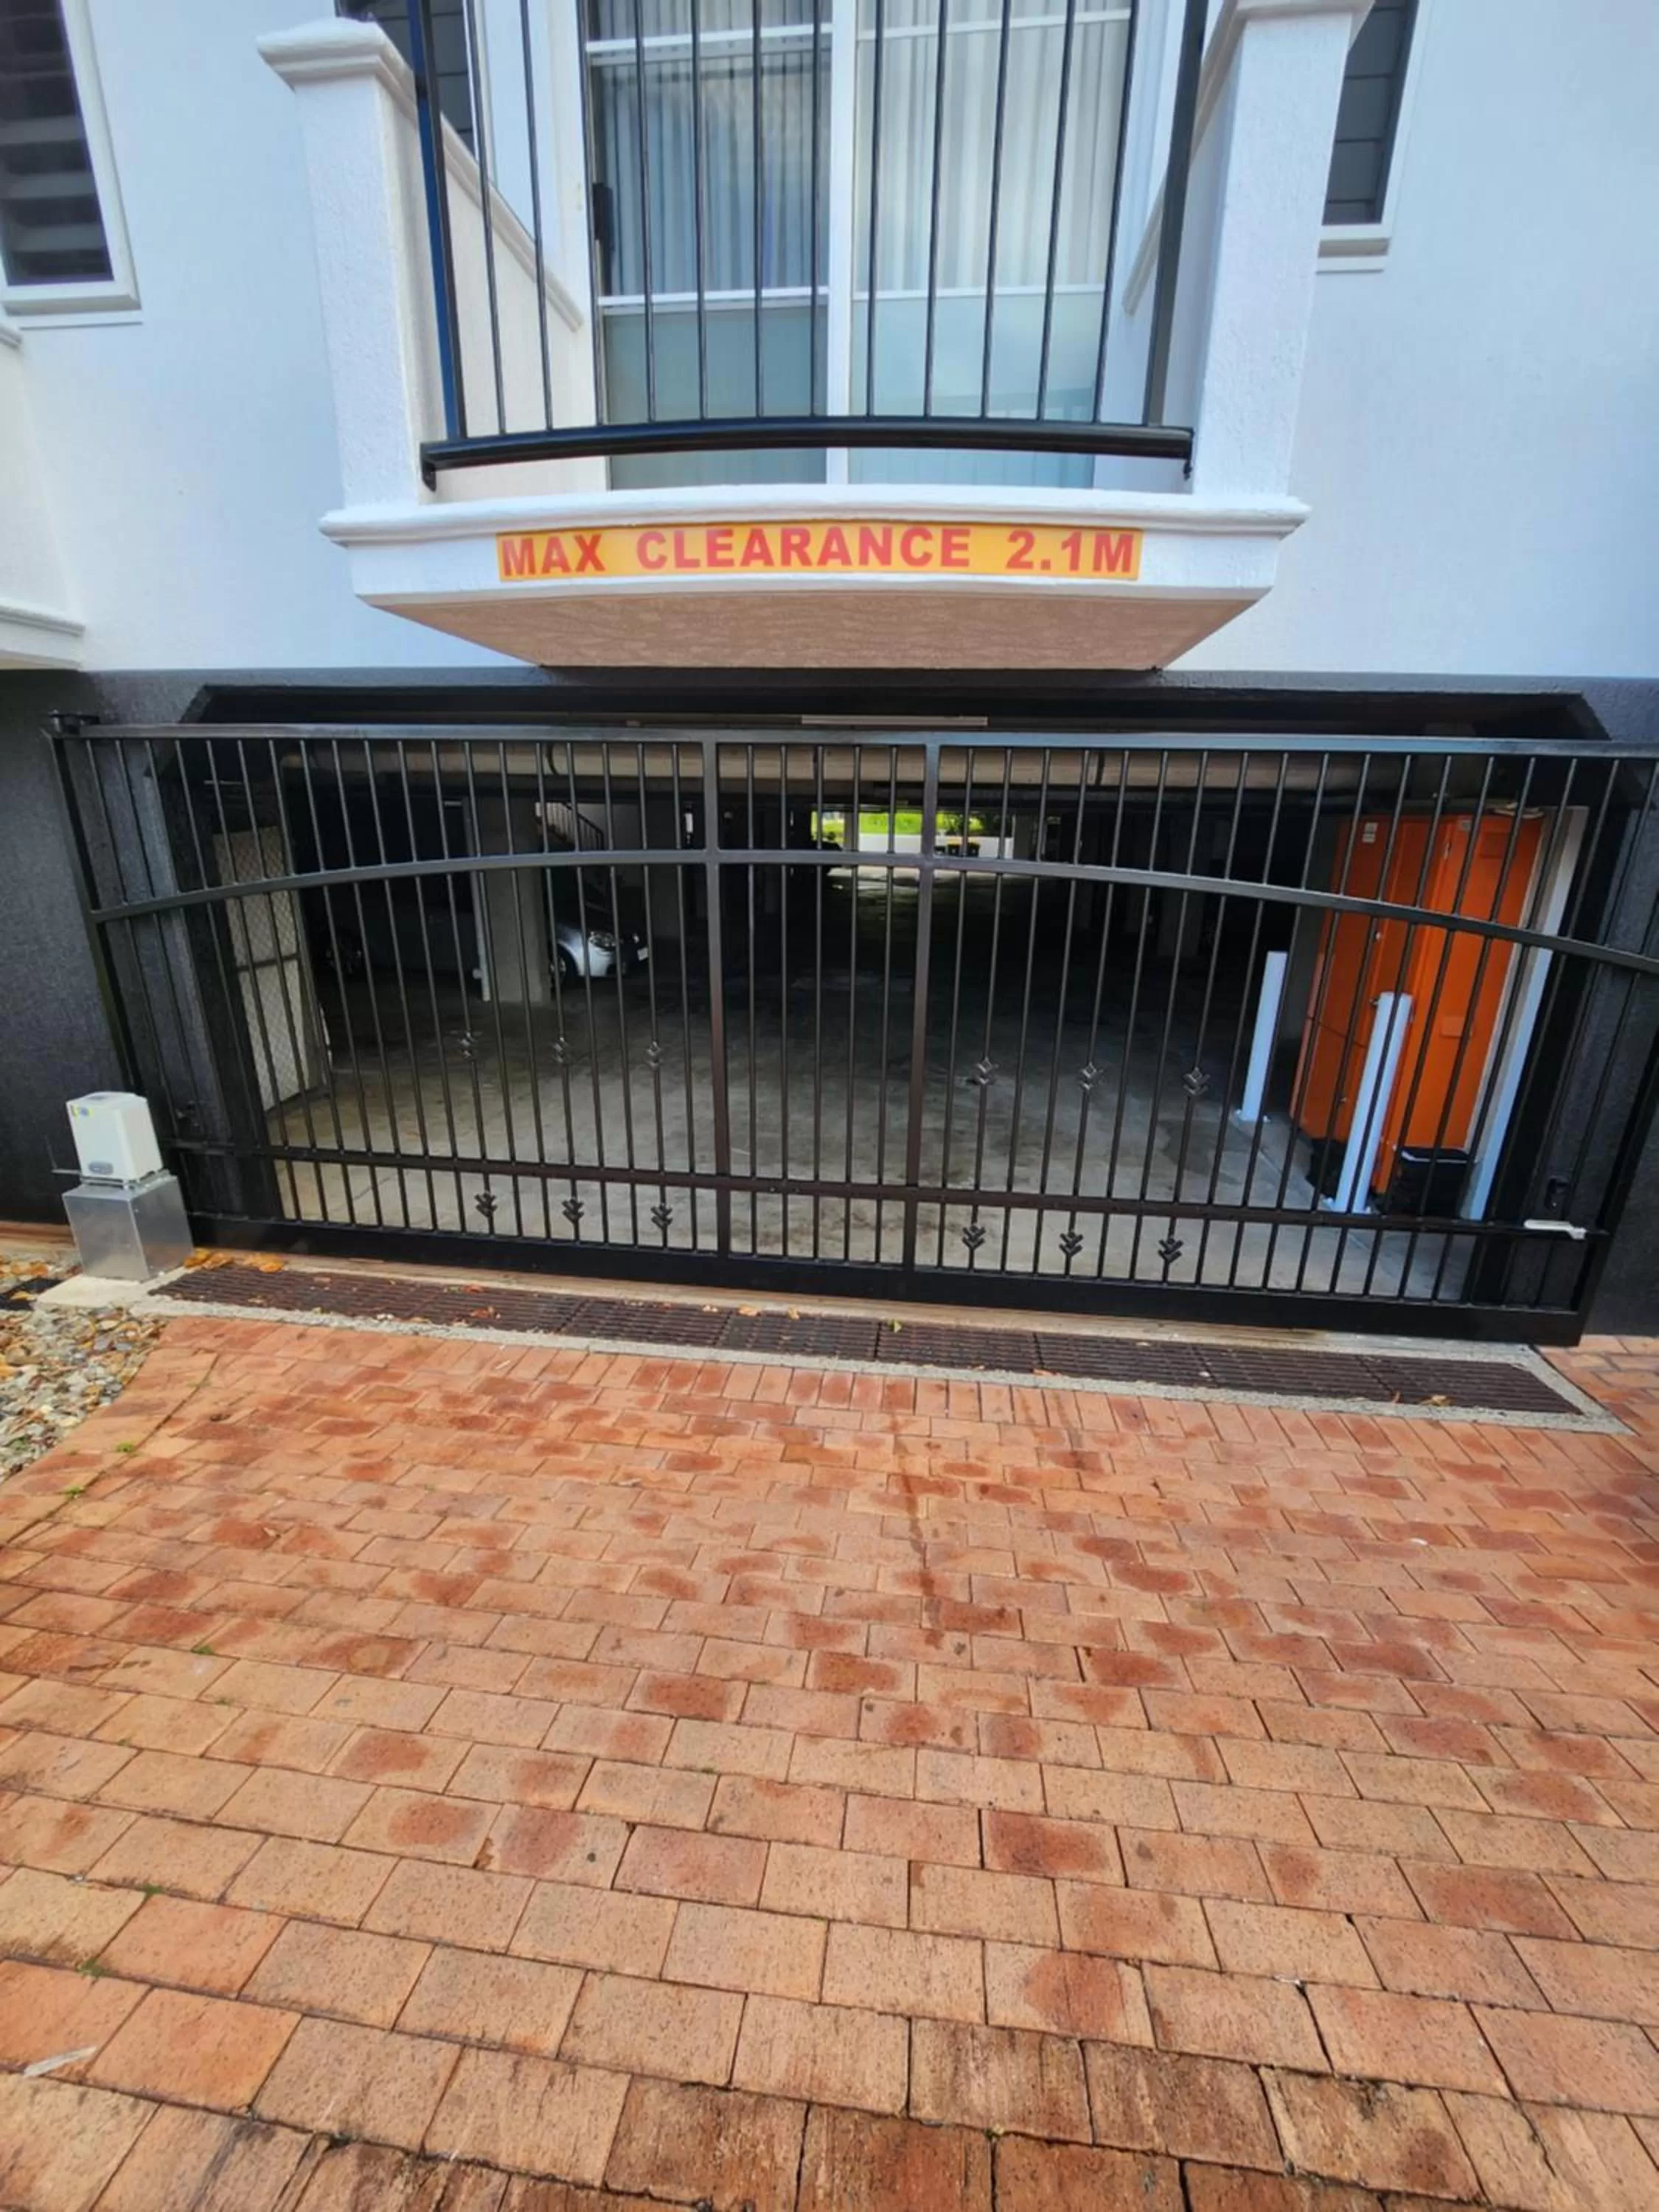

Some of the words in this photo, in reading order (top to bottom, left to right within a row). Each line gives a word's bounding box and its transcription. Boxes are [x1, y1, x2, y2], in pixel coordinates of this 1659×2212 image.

[501, 533, 606, 577] MAX
[636, 526, 971, 570] CLEARANCE
[1006, 529, 1134, 573] 2.1M
